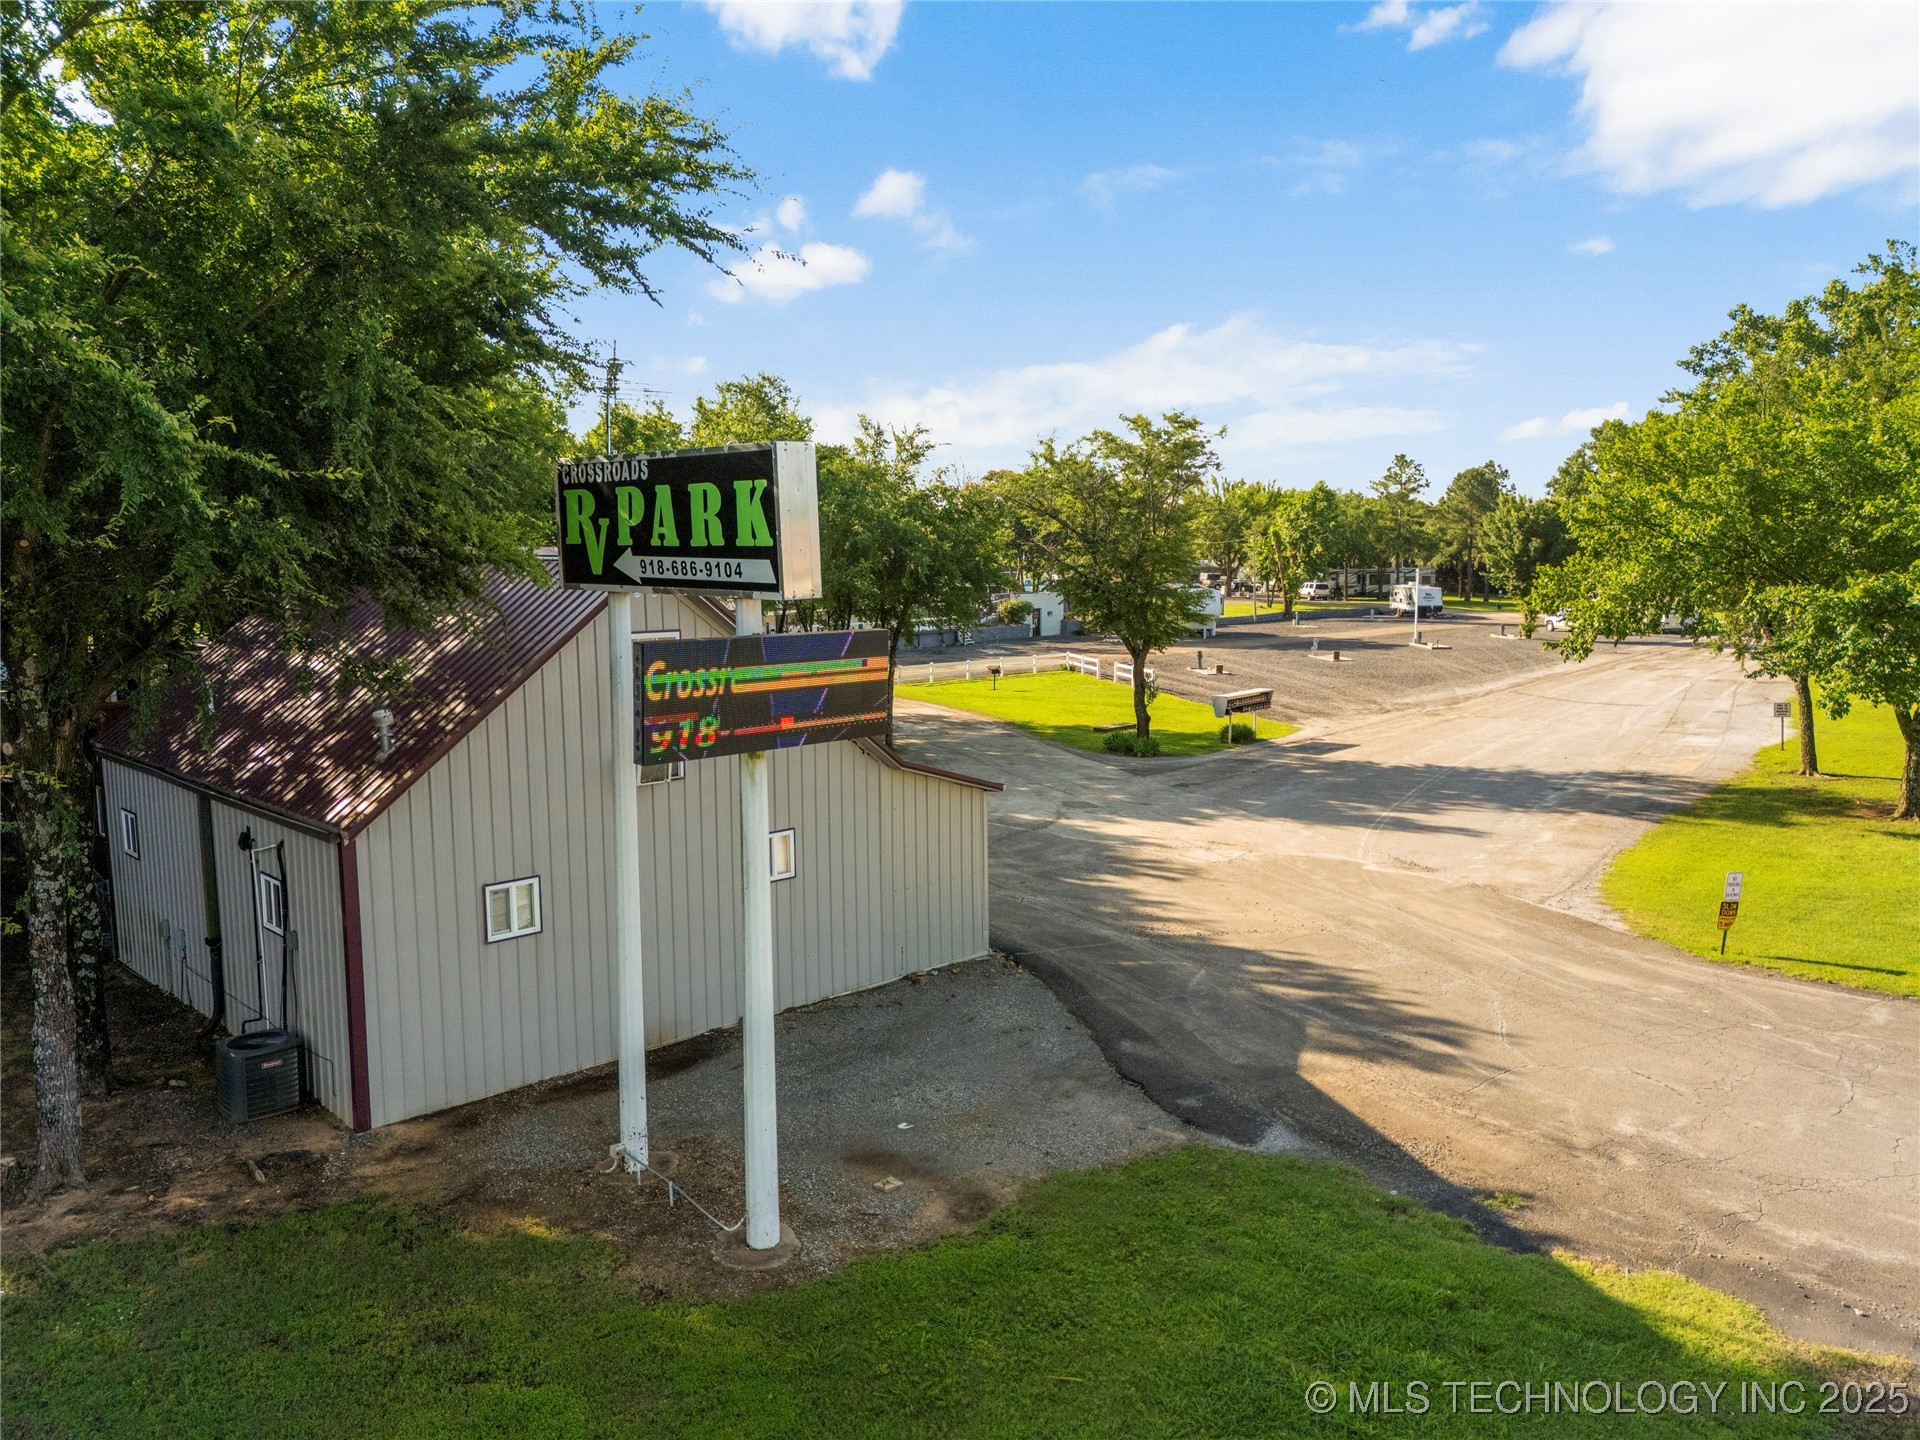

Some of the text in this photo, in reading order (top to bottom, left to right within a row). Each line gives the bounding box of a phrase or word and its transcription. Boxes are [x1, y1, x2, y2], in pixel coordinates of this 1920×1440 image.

[562, 460, 649, 484] CROSSROADS
[563, 479, 774, 575] RV PARK
[640, 559, 743, 579] 918-686-9104
